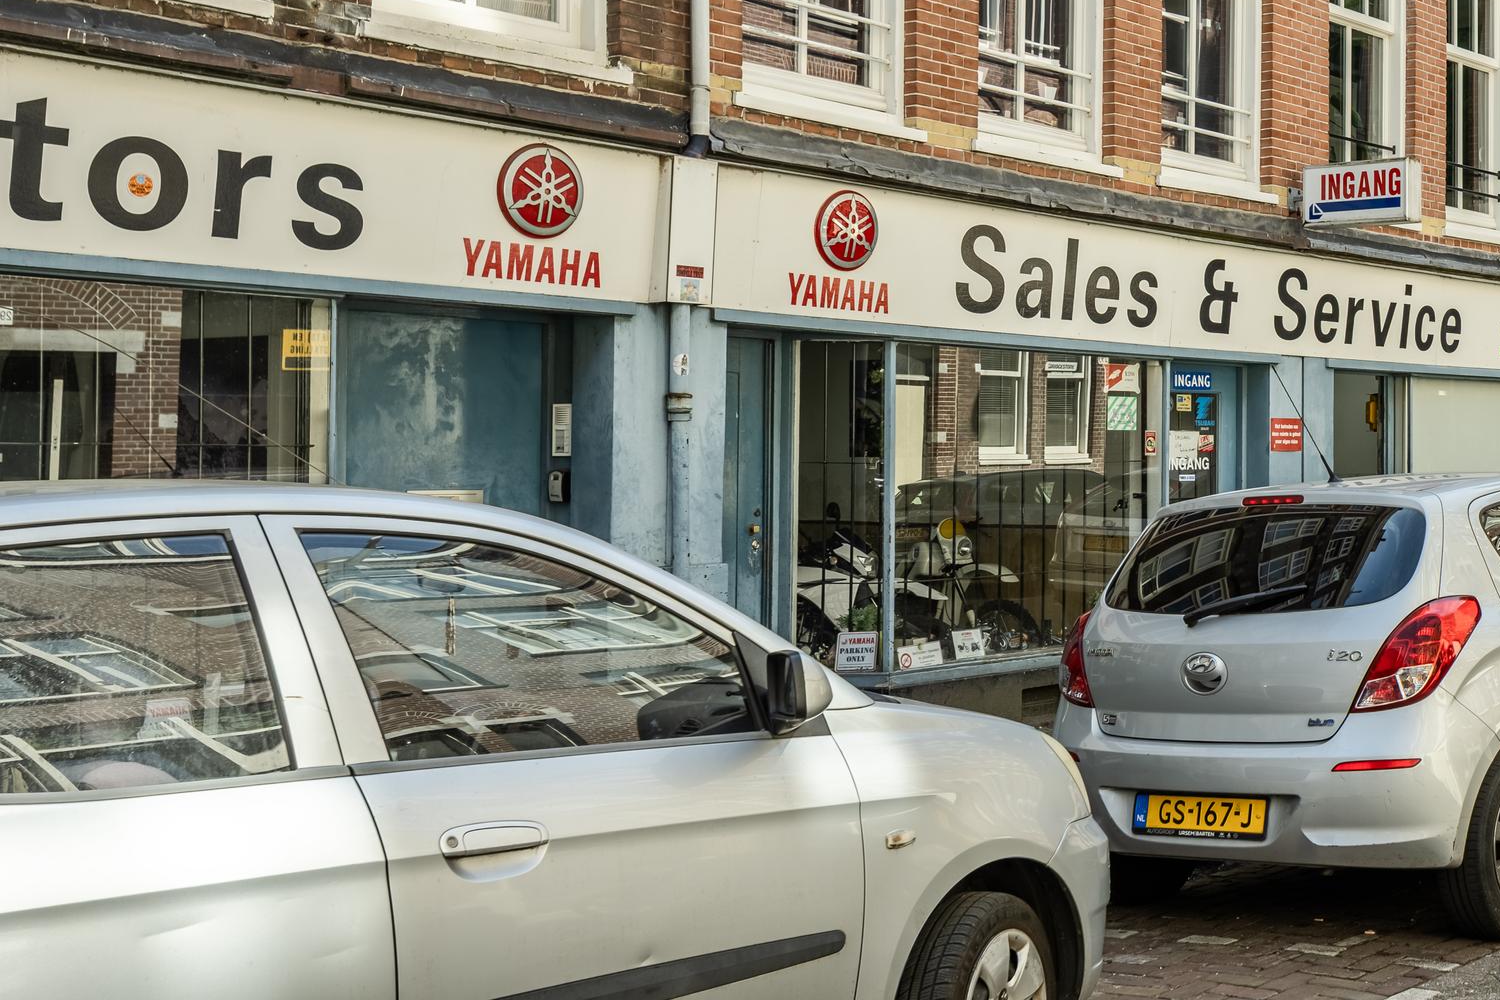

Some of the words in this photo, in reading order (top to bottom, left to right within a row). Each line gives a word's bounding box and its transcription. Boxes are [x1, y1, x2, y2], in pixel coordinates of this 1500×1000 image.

[0, 97, 364, 251] tors
[1320, 167, 1402, 201] INGANG
[463, 237, 601, 288] YAMAHA
[788, 272, 889, 315] YAMAHA
[955, 224, 1159, 328] Sales
[1199, 258, 1238, 335] &
[1273, 267, 1462, 354] Service
[1174, 374, 1211, 388] INGANG
[1169, 457, 1210, 471] INGANG
[839, 646, 874, 655] PARKING
[848, 637, 875, 645] YAMAHA
[1327, 649, 1363, 662] i20
[1136, 814, 1146, 823] NL
[1158, 799, 1253, 828] GS-167-J
